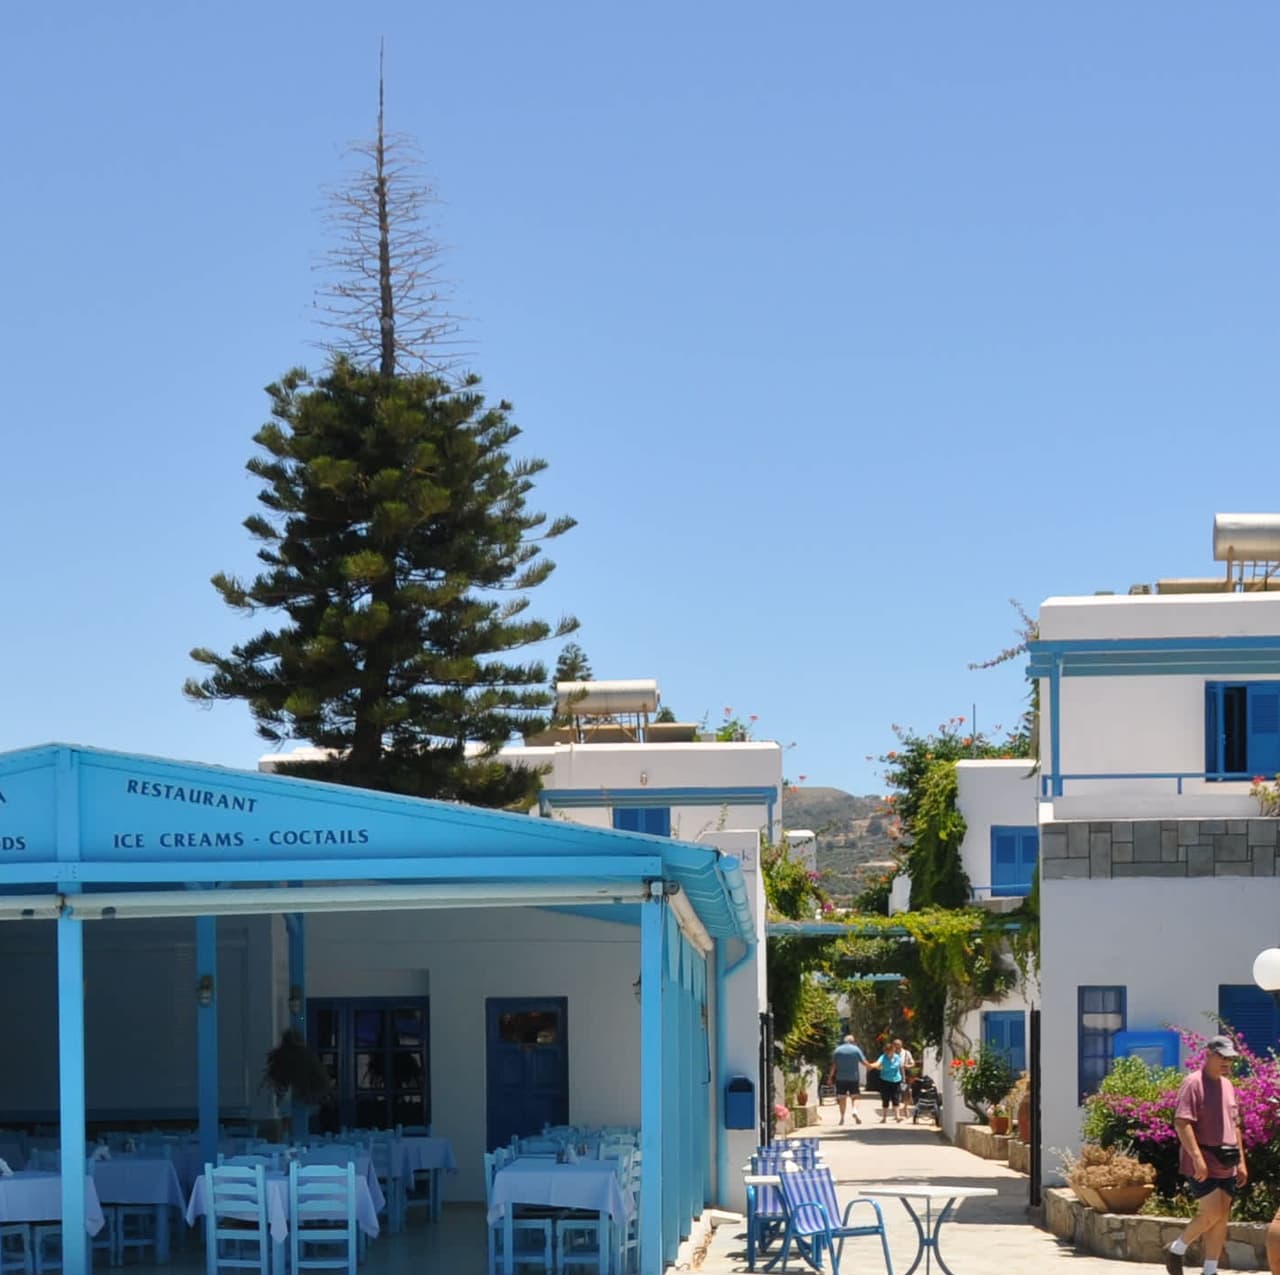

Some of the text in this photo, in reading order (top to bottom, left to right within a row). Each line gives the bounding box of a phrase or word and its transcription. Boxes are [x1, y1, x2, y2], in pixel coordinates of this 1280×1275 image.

[127, 779, 257, 813] RESTAURANT
[113, 833, 145, 849] ICE
[159, 831, 244, 848] CREAMS
[269, 828, 369, 845] COCTAILS
